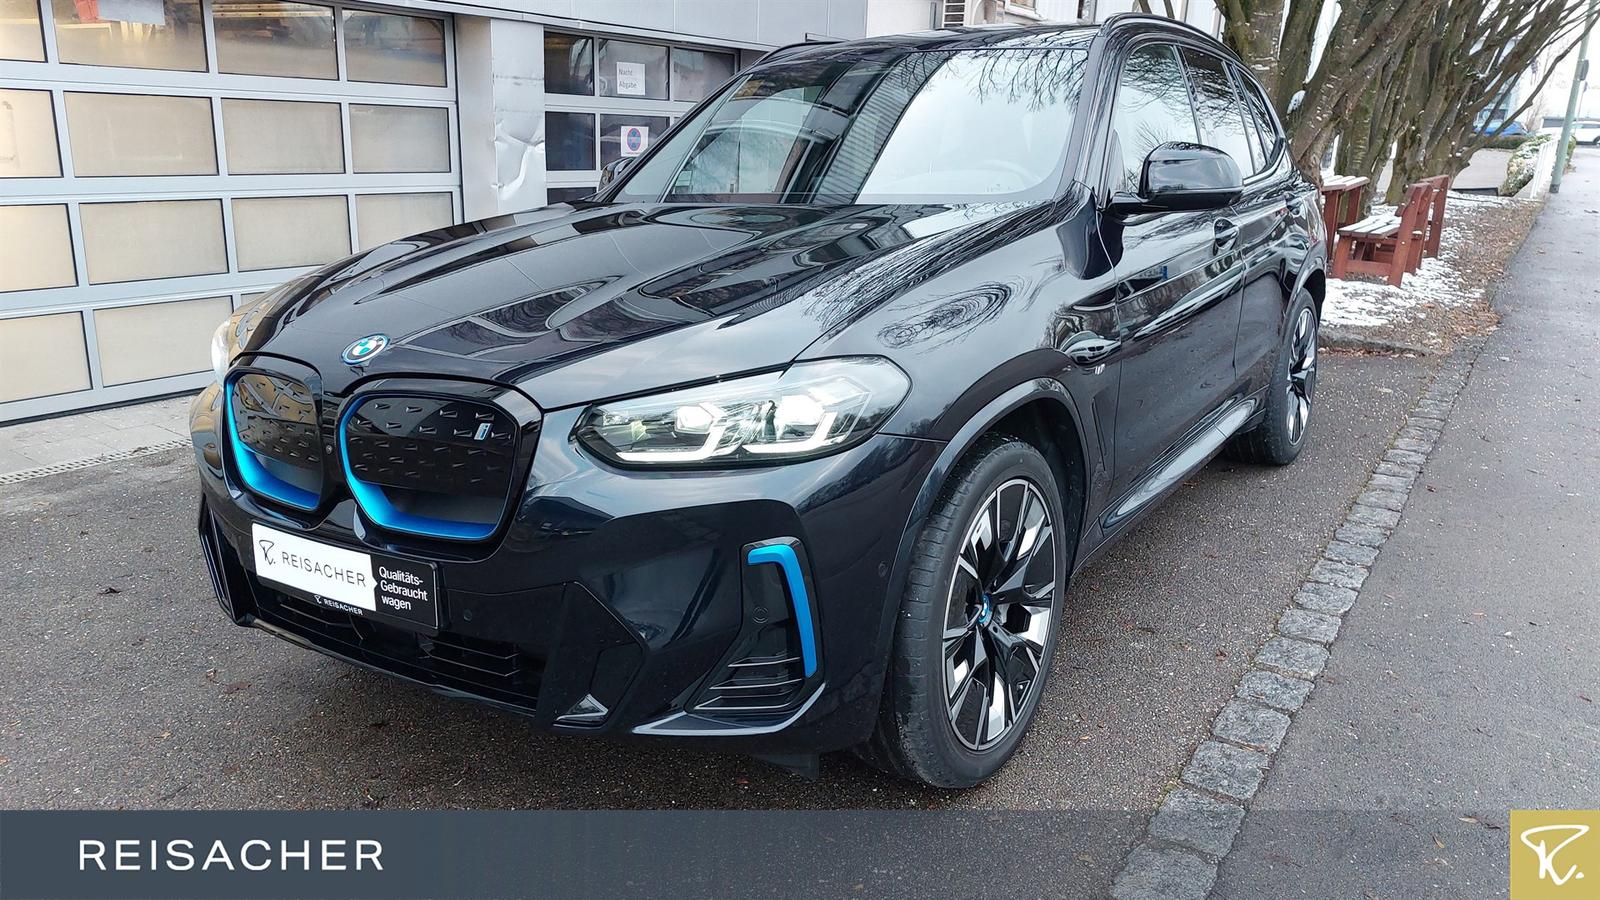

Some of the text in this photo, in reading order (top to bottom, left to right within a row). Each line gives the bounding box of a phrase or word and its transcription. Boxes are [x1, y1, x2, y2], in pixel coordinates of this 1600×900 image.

[618, 82, 638, 90] Abgabe
[281, 551, 367, 588] REISACHER
[378, 566, 424, 587] Qualitäts-
[379, 580, 429, 602] Gebraucht
[323, 598, 364, 616] REISACHER
[381, 594, 412, 611] wagen
